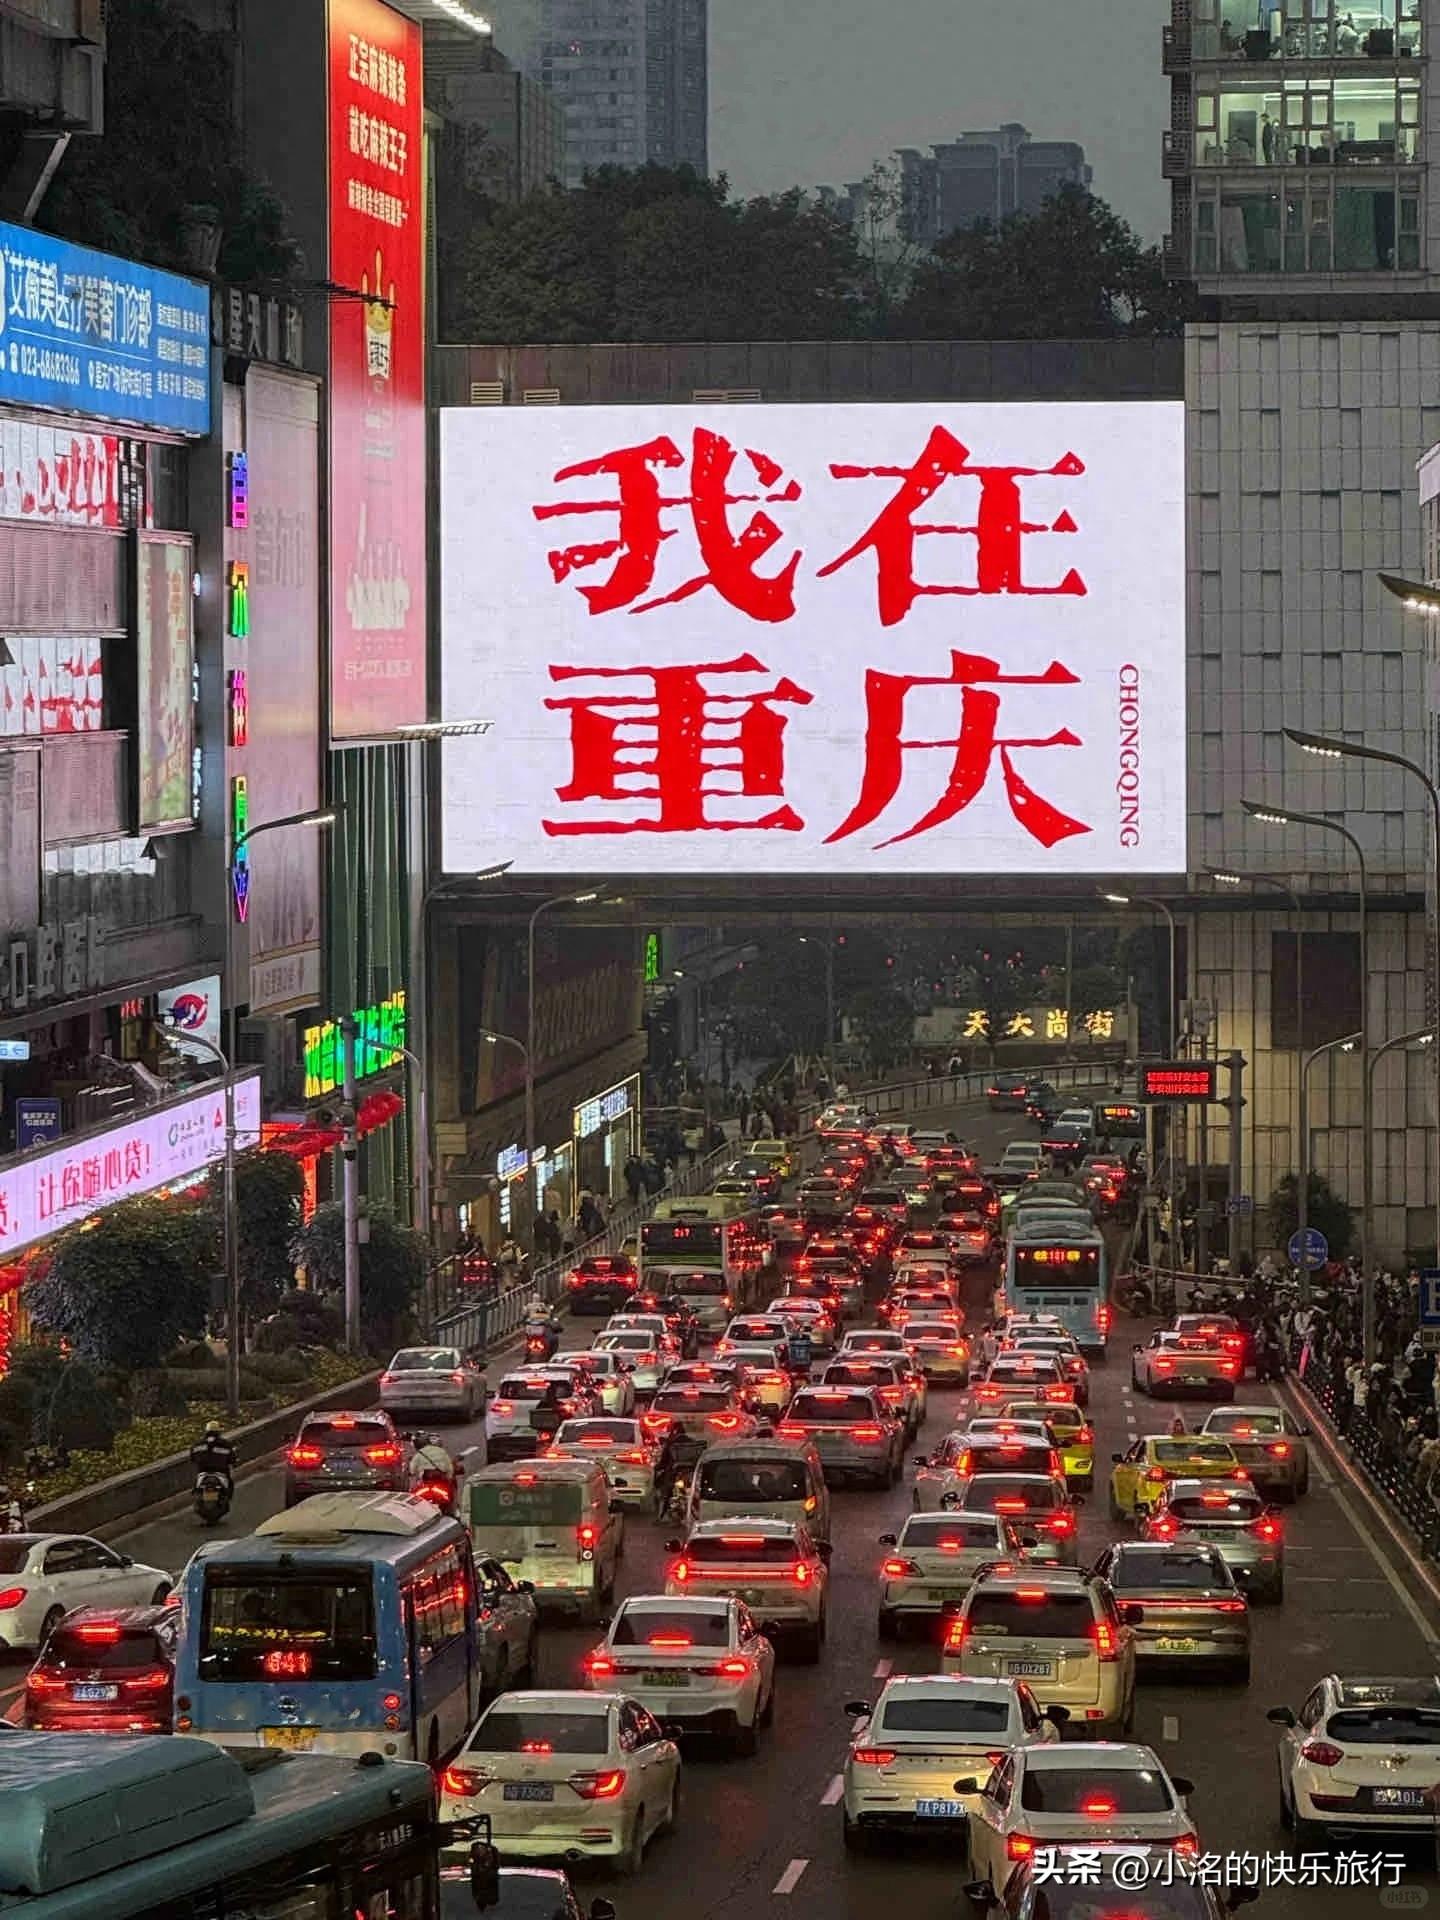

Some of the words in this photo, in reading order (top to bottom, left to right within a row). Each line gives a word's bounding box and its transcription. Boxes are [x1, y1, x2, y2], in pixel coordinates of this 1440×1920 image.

[349, 105, 407, 177] 就吃麻辣王子
[533, 425, 1087, 627] 我在
[542, 649, 1093, 849] 重庆
[1118, 663, 1141, 848] CHONGQING
